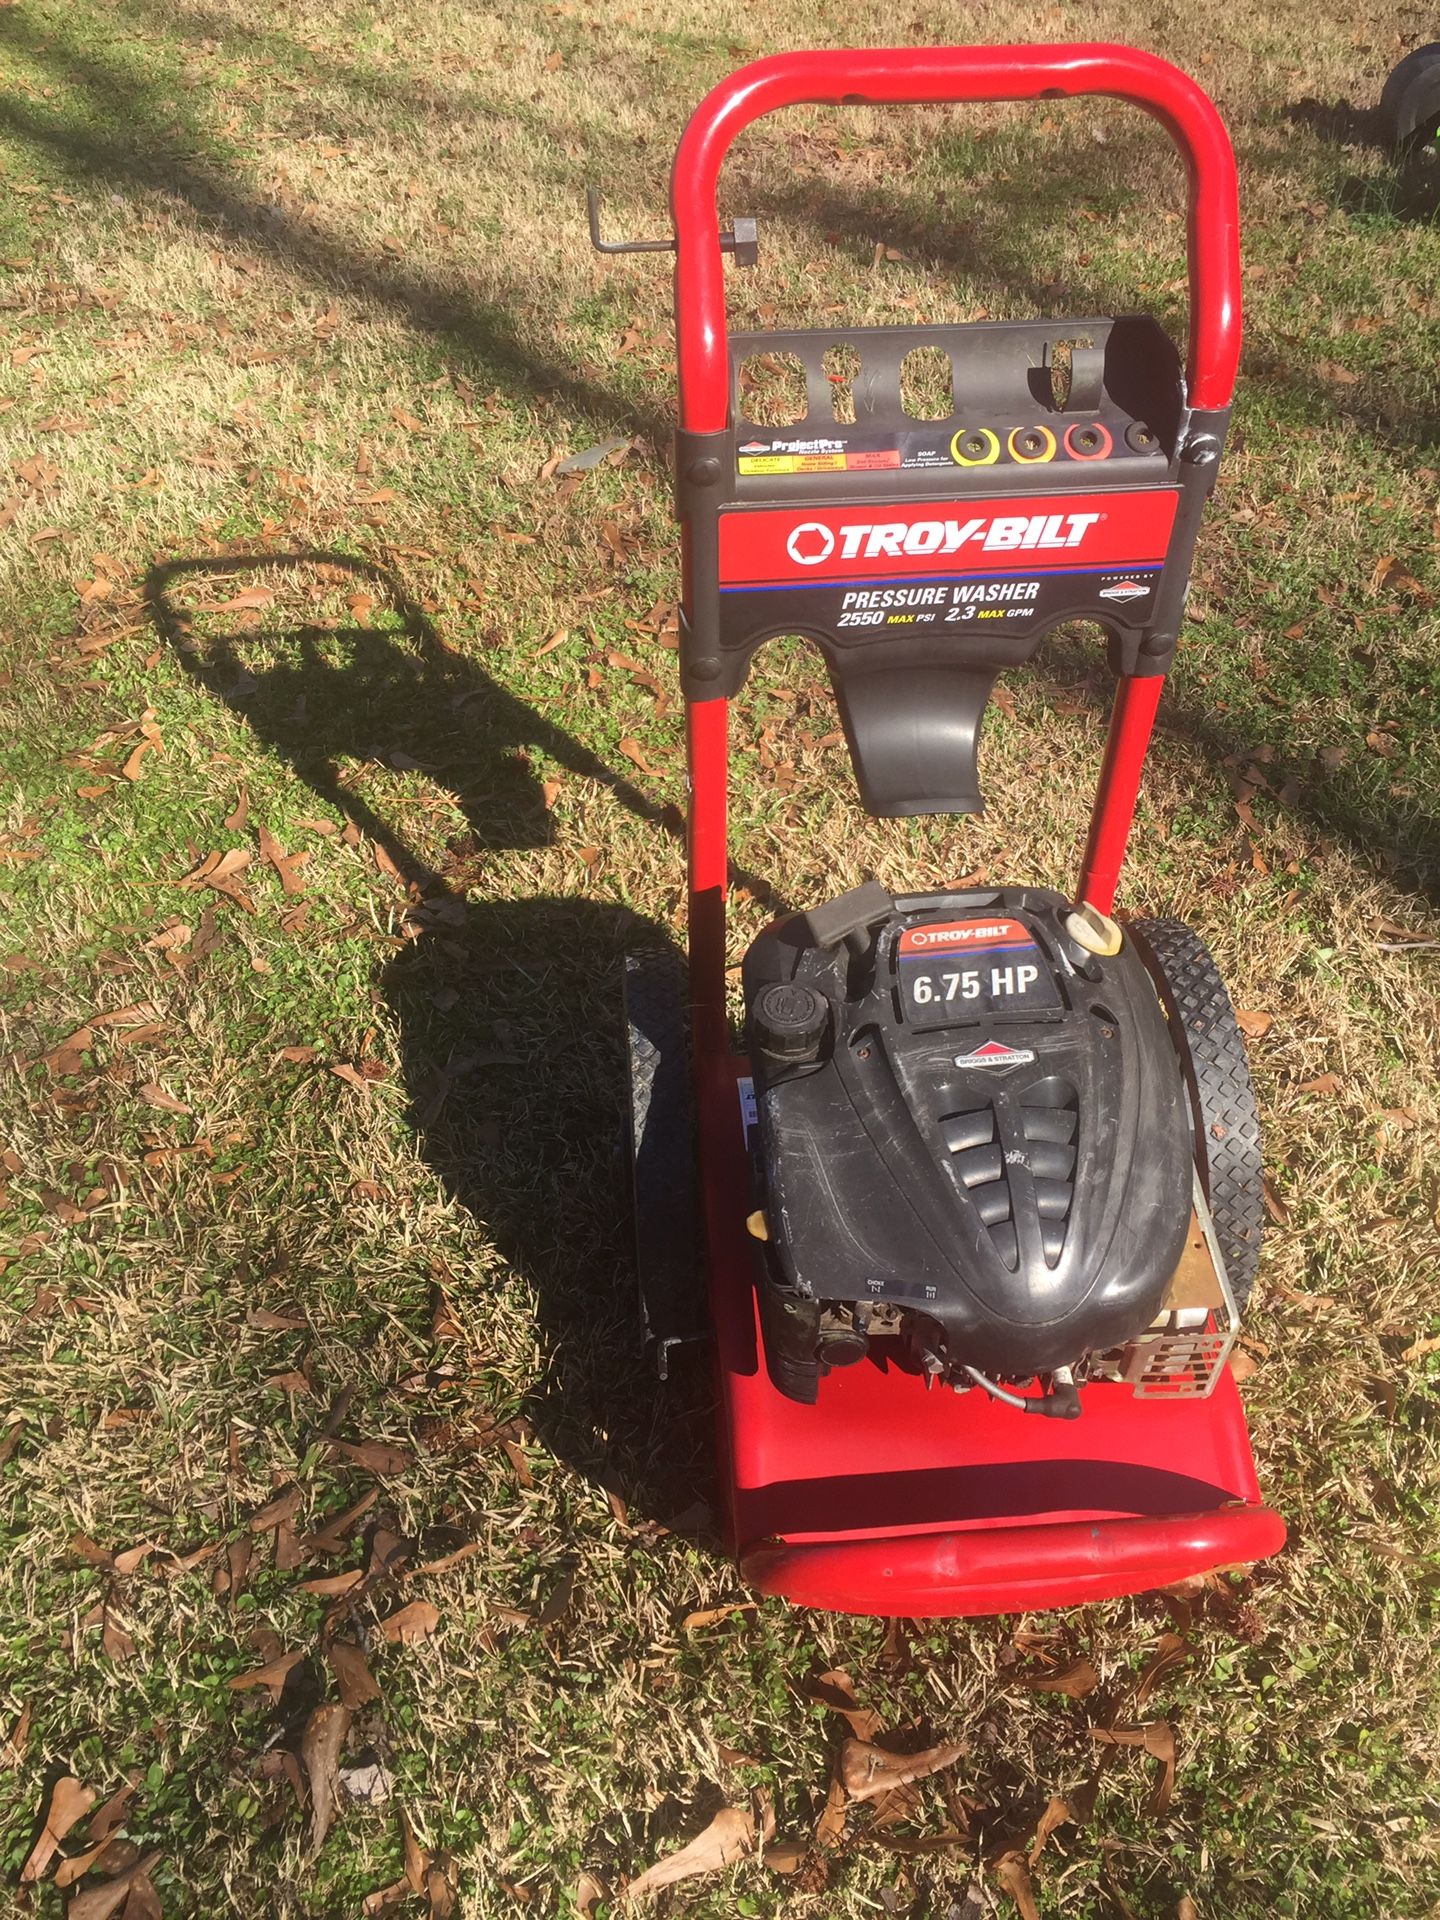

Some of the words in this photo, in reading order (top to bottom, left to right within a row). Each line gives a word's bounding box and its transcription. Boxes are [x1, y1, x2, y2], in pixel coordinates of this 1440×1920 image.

[839, 512, 1101, 559] TROY-BILT
[842, 586, 947, 610] PRESSURE
[952, 582, 1041, 605] WASHER
[837, 610, 884, 627] 2550
[887, 614, 915, 624] MAX
[916, 613, 936, 623] PSI
[944, 605, 975, 622] 2.3
[977, 609, 1006, 619] MAX
[1006, 607, 1034, 618] GPM
[927, 925, 1010, 944] TROY-BILT
[913, 970, 980, 1004] 6.75
[991, 965, 1039, 996] HP
[959, 1057, 987, 1065] BRIGGS
[993, 1054, 1030, 1063] STRATTON
